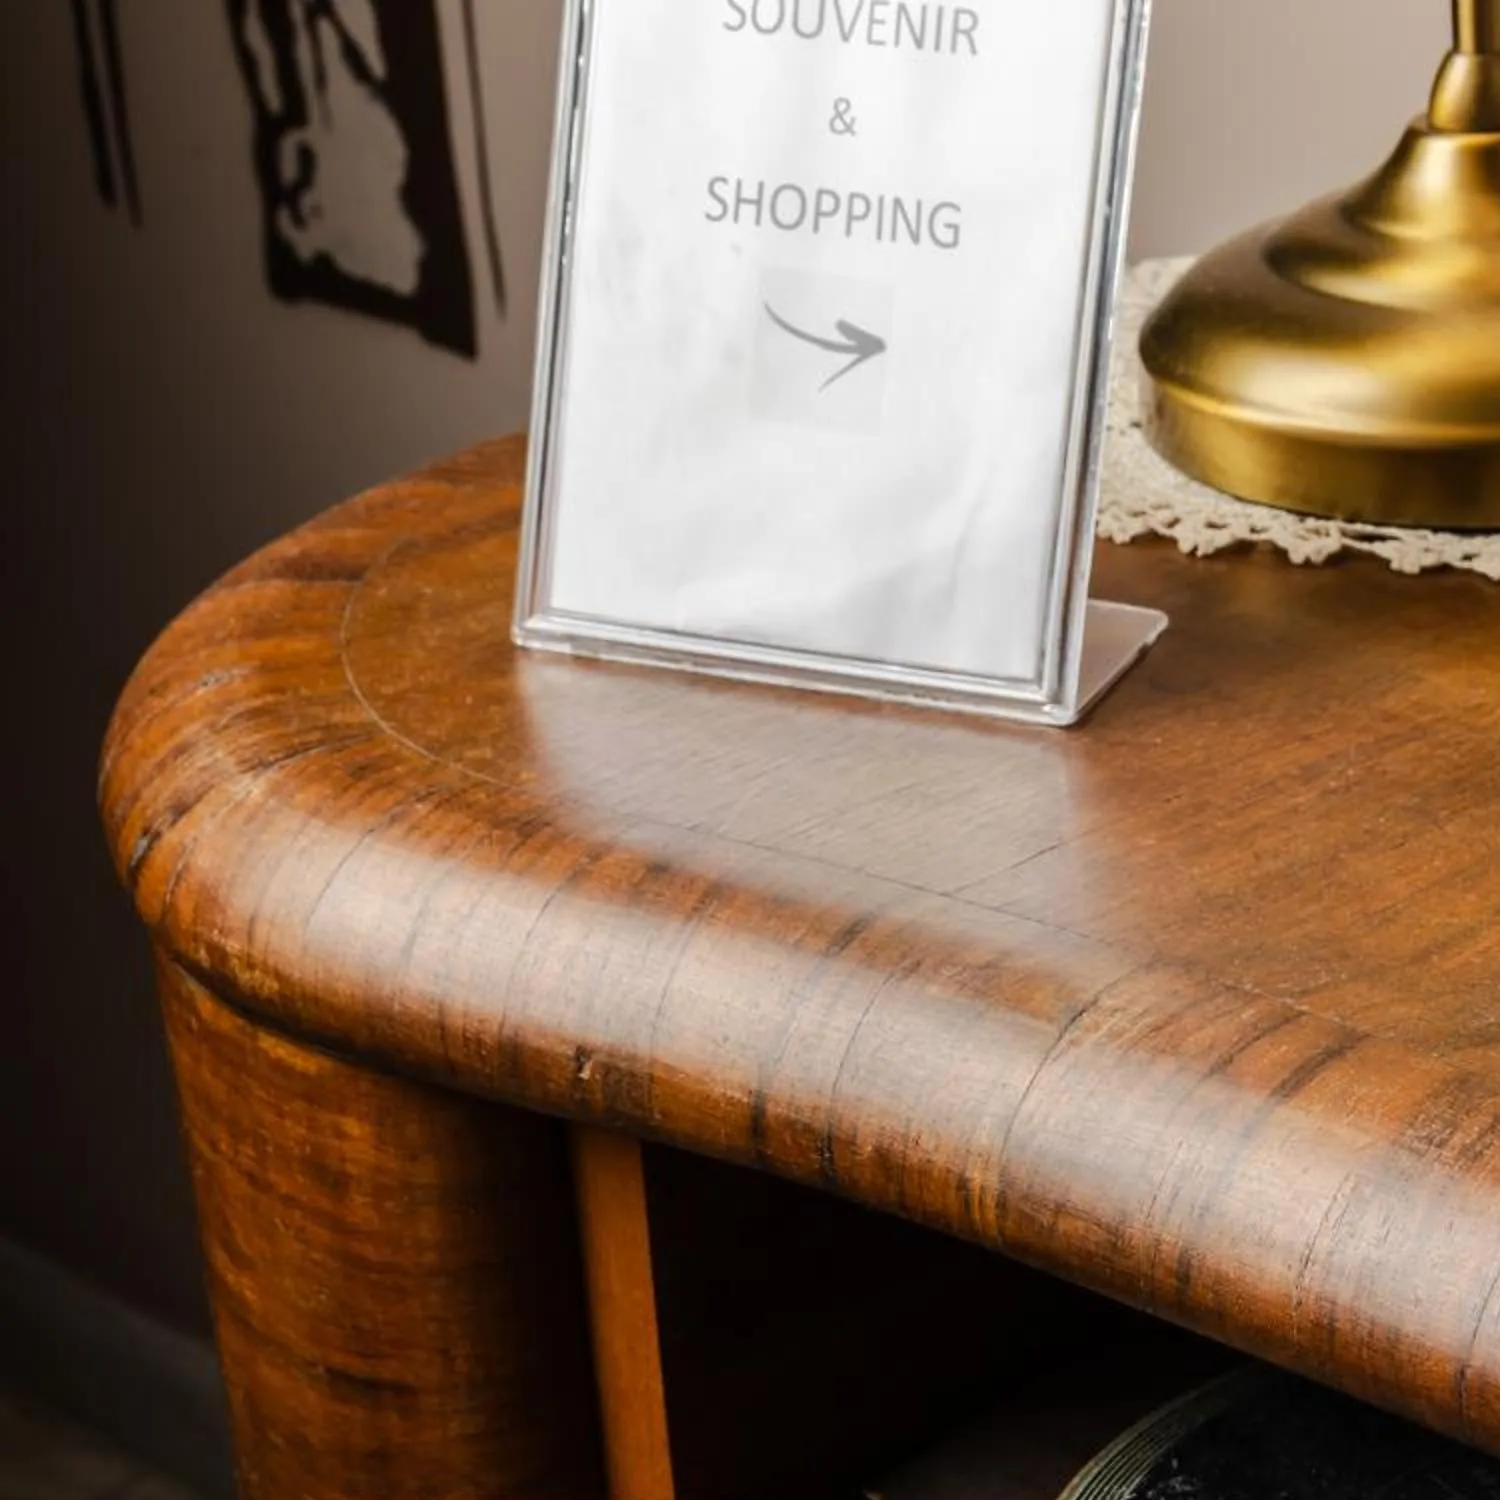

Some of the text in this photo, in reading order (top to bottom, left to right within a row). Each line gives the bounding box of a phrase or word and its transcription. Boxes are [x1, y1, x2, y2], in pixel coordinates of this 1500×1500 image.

[723, 0, 979, 56] SOUVENIR
[828, 96, 857, 136] &
[704, 175, 962, 250] SHOPPING
